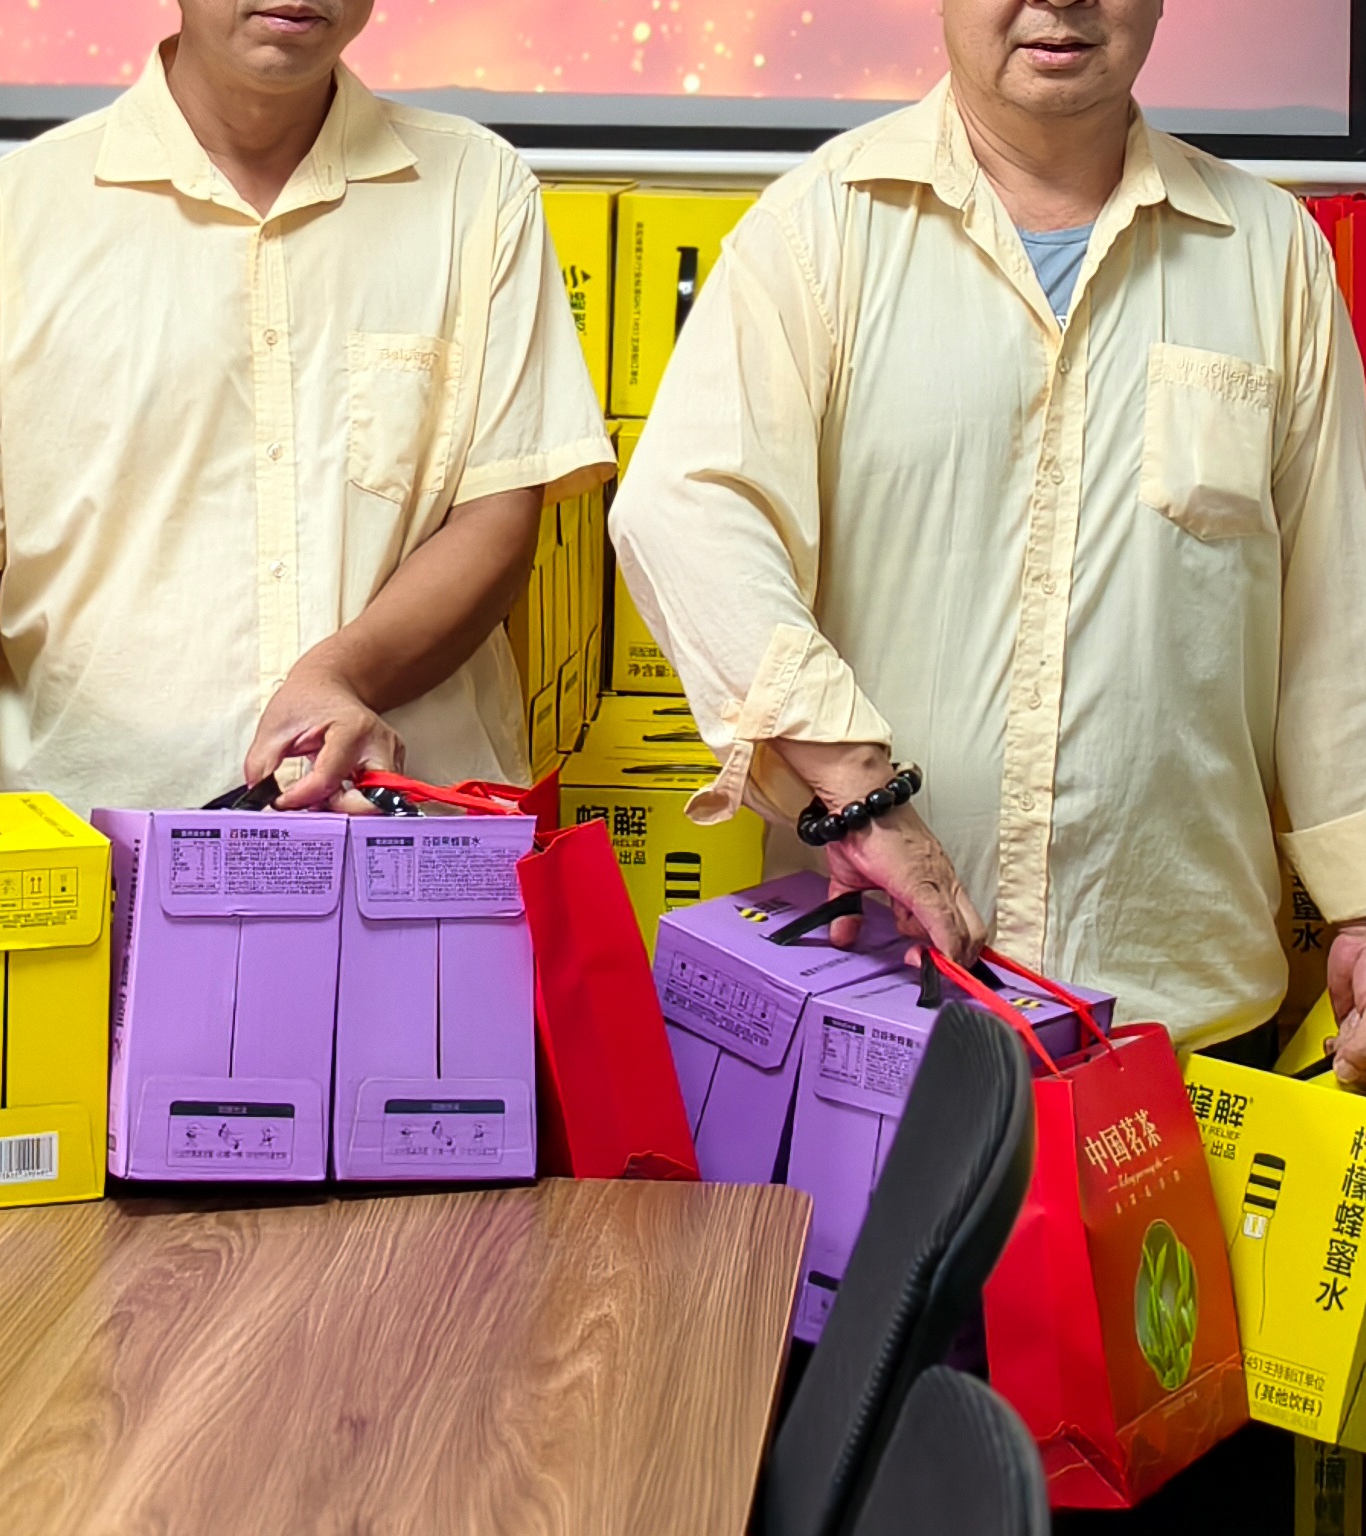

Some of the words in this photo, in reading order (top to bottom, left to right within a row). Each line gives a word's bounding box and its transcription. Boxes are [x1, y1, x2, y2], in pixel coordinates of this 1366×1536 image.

[628, 664, 676, 678] 净含量:
[619, 850, 646, 865] 出品
[1291, 875, 1325, 953] 蜜水
[1185, 1081, 1248, 1128] 蜂解
[1084, 1109, 1162, 1174] 中国茗茶
[1210, 1125, 1241, 1140] RELIEF
[1210, 1140, 1236, 1160] 出品
[1254, 1381, 1323, 1418] (其他饮料)
